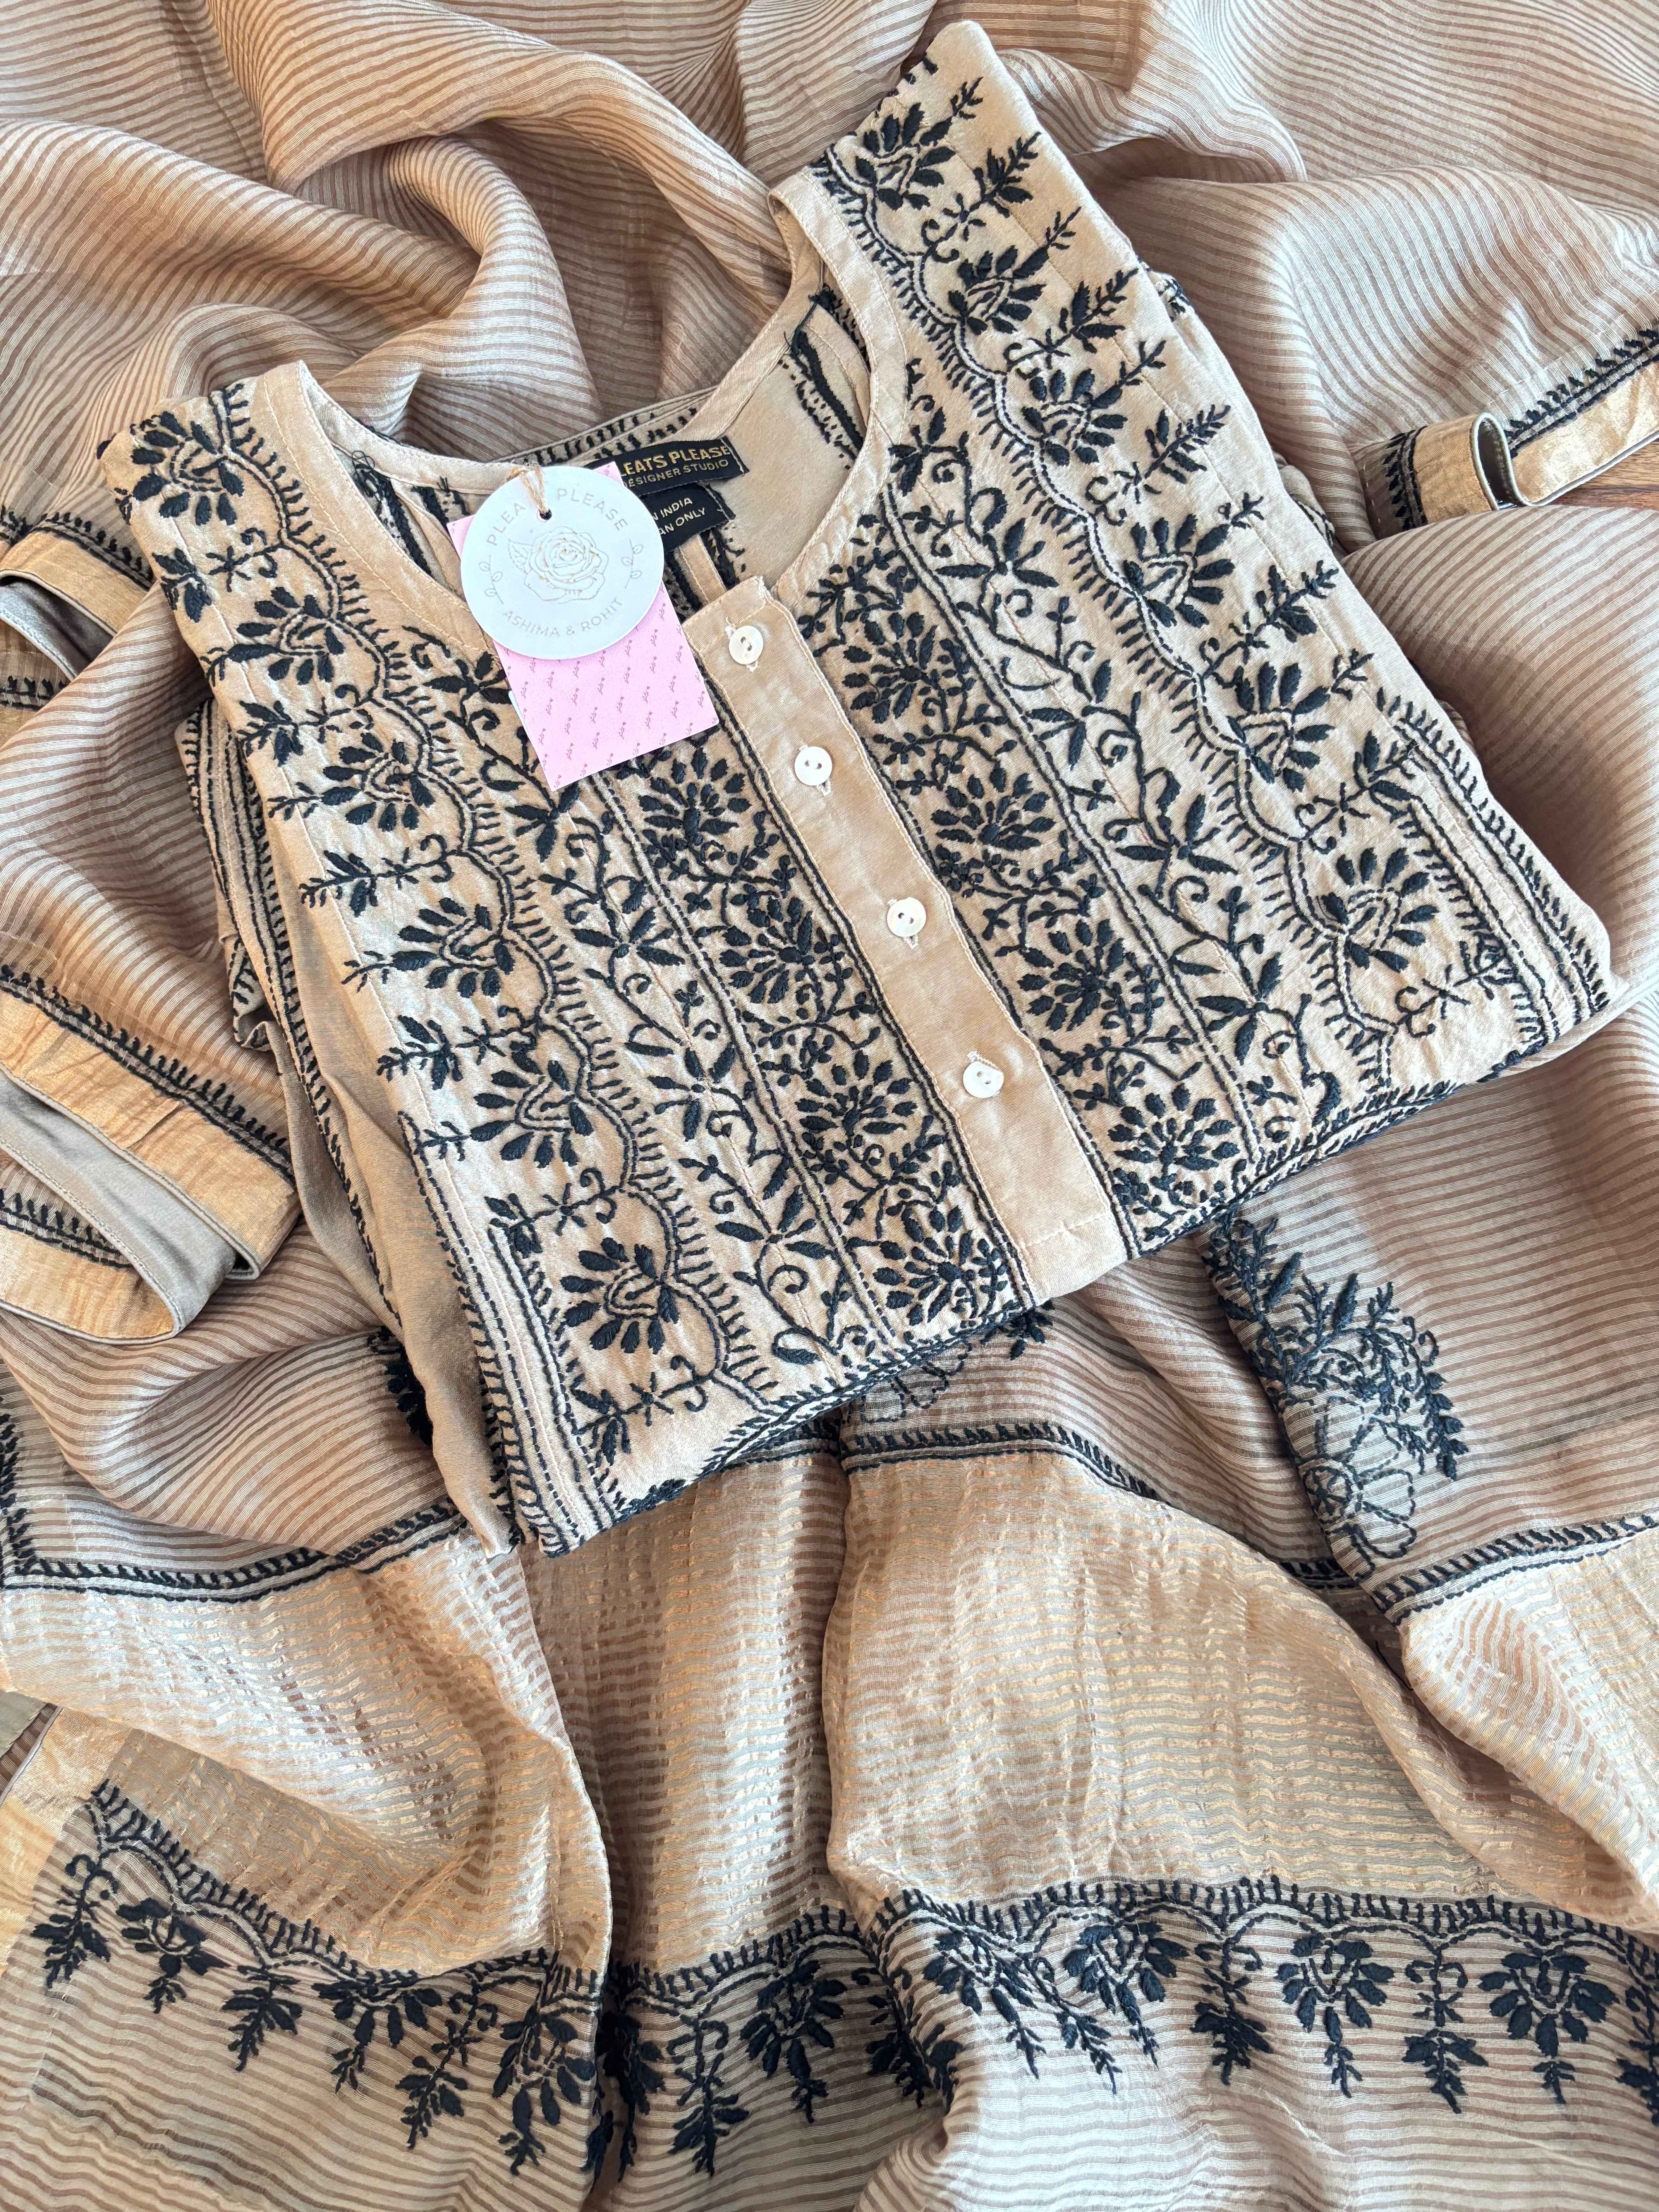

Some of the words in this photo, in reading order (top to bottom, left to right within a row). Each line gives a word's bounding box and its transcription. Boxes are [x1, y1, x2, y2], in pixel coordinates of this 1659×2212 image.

[621, 455, 668, 476] EATS
[668, 446, 731, 464] PLEASE
[683, 459, 729, 473] STUDIO
[487, 503, 526, 546] PLEA
[557, 488, 628, 531] PLEASE
[659, 523, 674, 534] AN
[675, 507, 705, 527] ONLY
[660, 497, 693, 518] INDIA
[502, 610, 560, 637] ASHIMA
[566, 625, 575, 635] &
[580, 597, 622, 632] ROHIT
